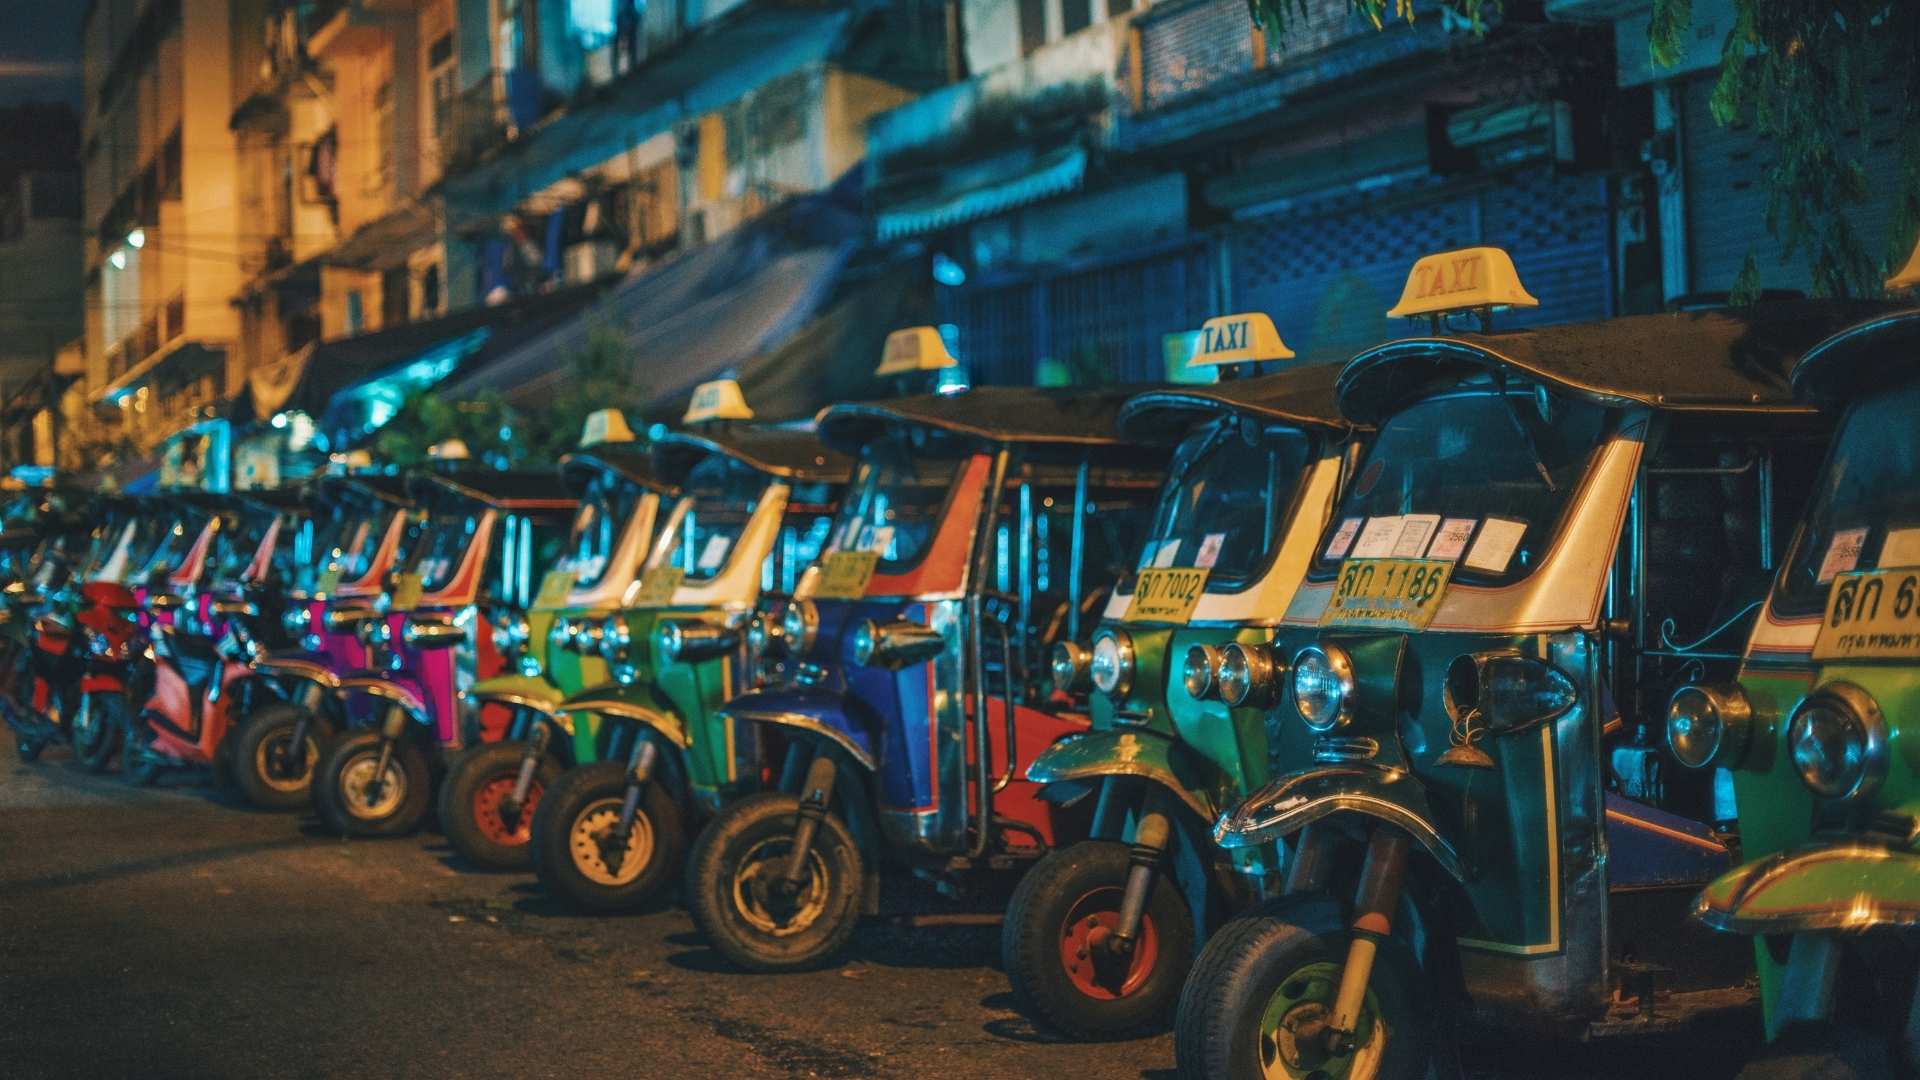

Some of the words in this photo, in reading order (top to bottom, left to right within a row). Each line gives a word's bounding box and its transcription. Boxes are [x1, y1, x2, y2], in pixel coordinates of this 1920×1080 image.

[1415, 255, 1481, 299] TAXI
[1204, 321, 1248, 354] TAXI
[1161, 573, 1201, 601] 7002
[1382, 565, 1444, 601] 1186
[1831, 577, 1883, 628] สก
[1894, 575, 1920, 619] 6
